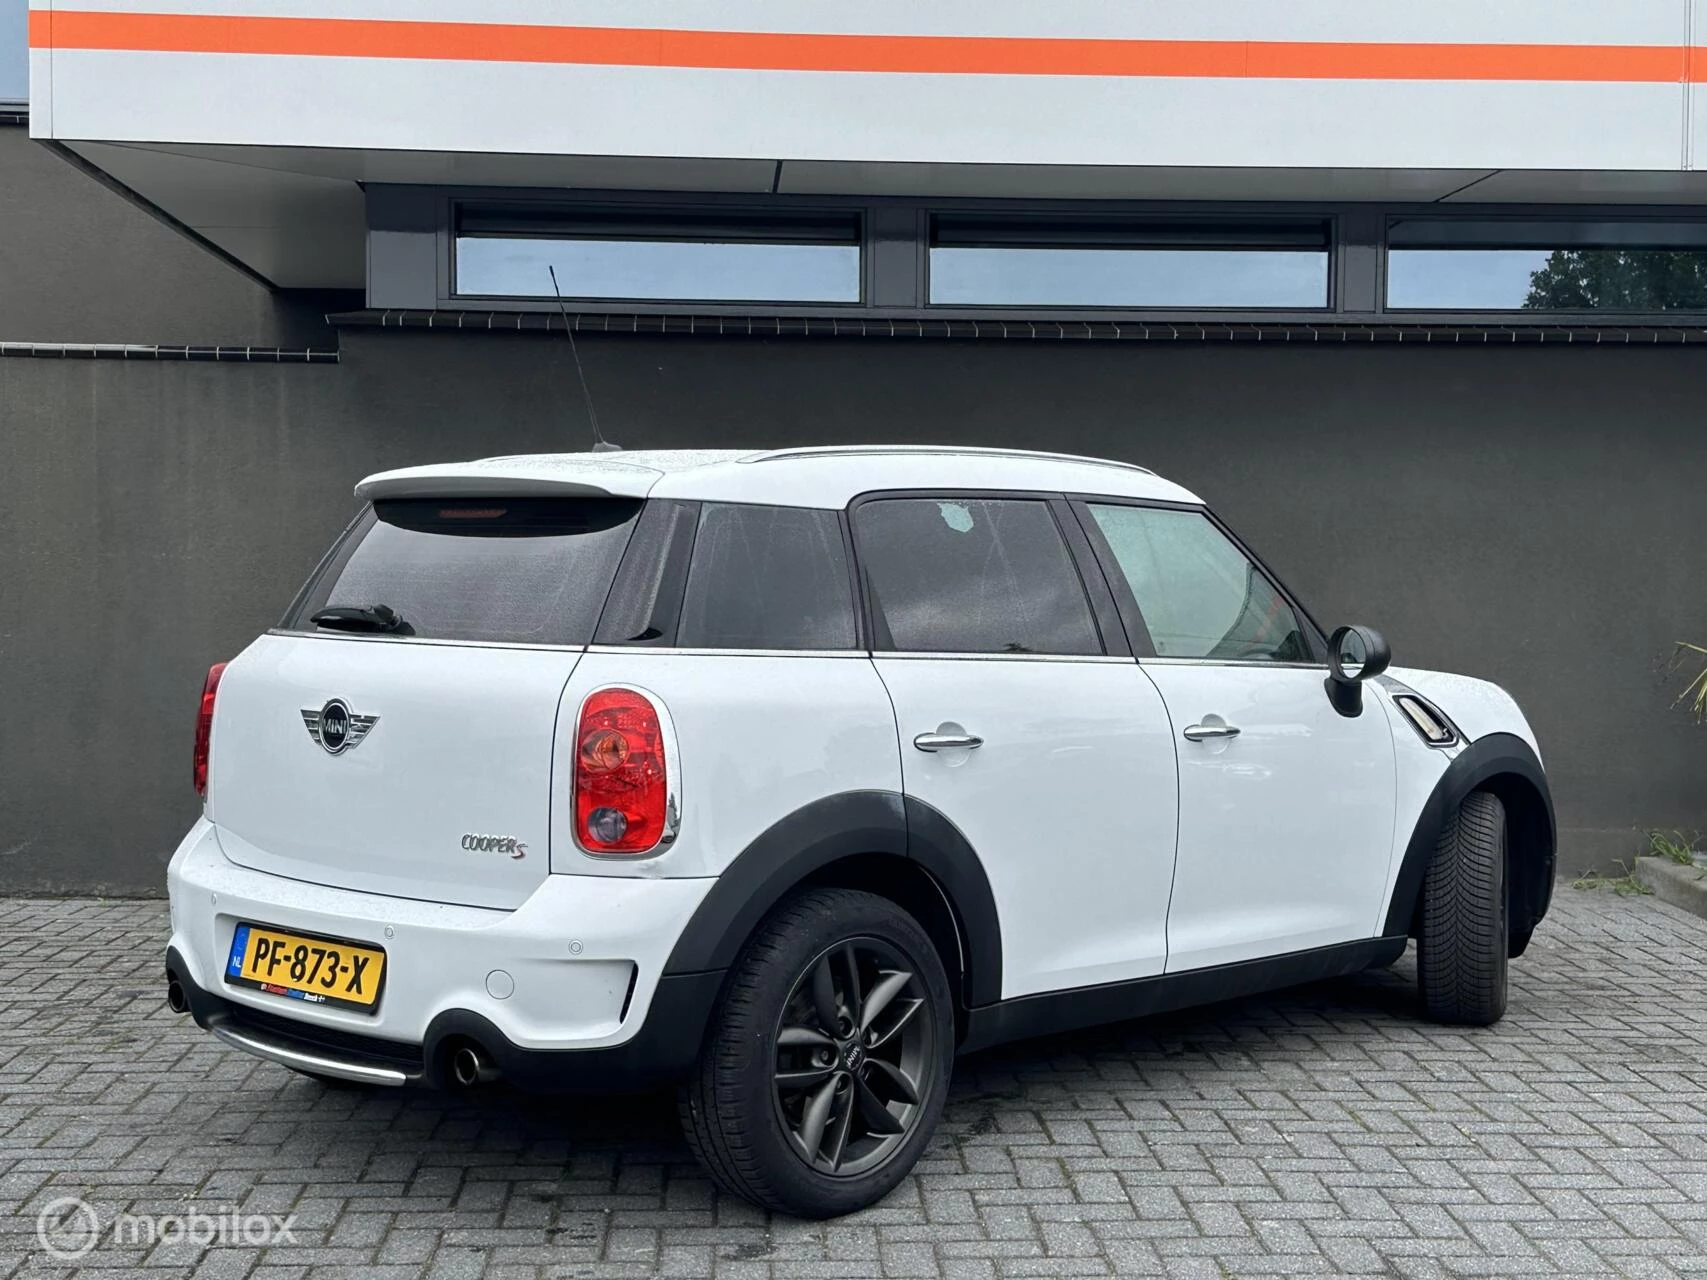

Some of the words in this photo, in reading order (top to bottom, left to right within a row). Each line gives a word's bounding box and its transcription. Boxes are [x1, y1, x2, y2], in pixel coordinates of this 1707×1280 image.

[323, 718, 348, 734] MINI
[461, 833, 517, 853] COOPER
[511, 843, 528, 860] S
[232, 955, 242, 968] NL
[251, 937, 370, 995] PF-873-X
